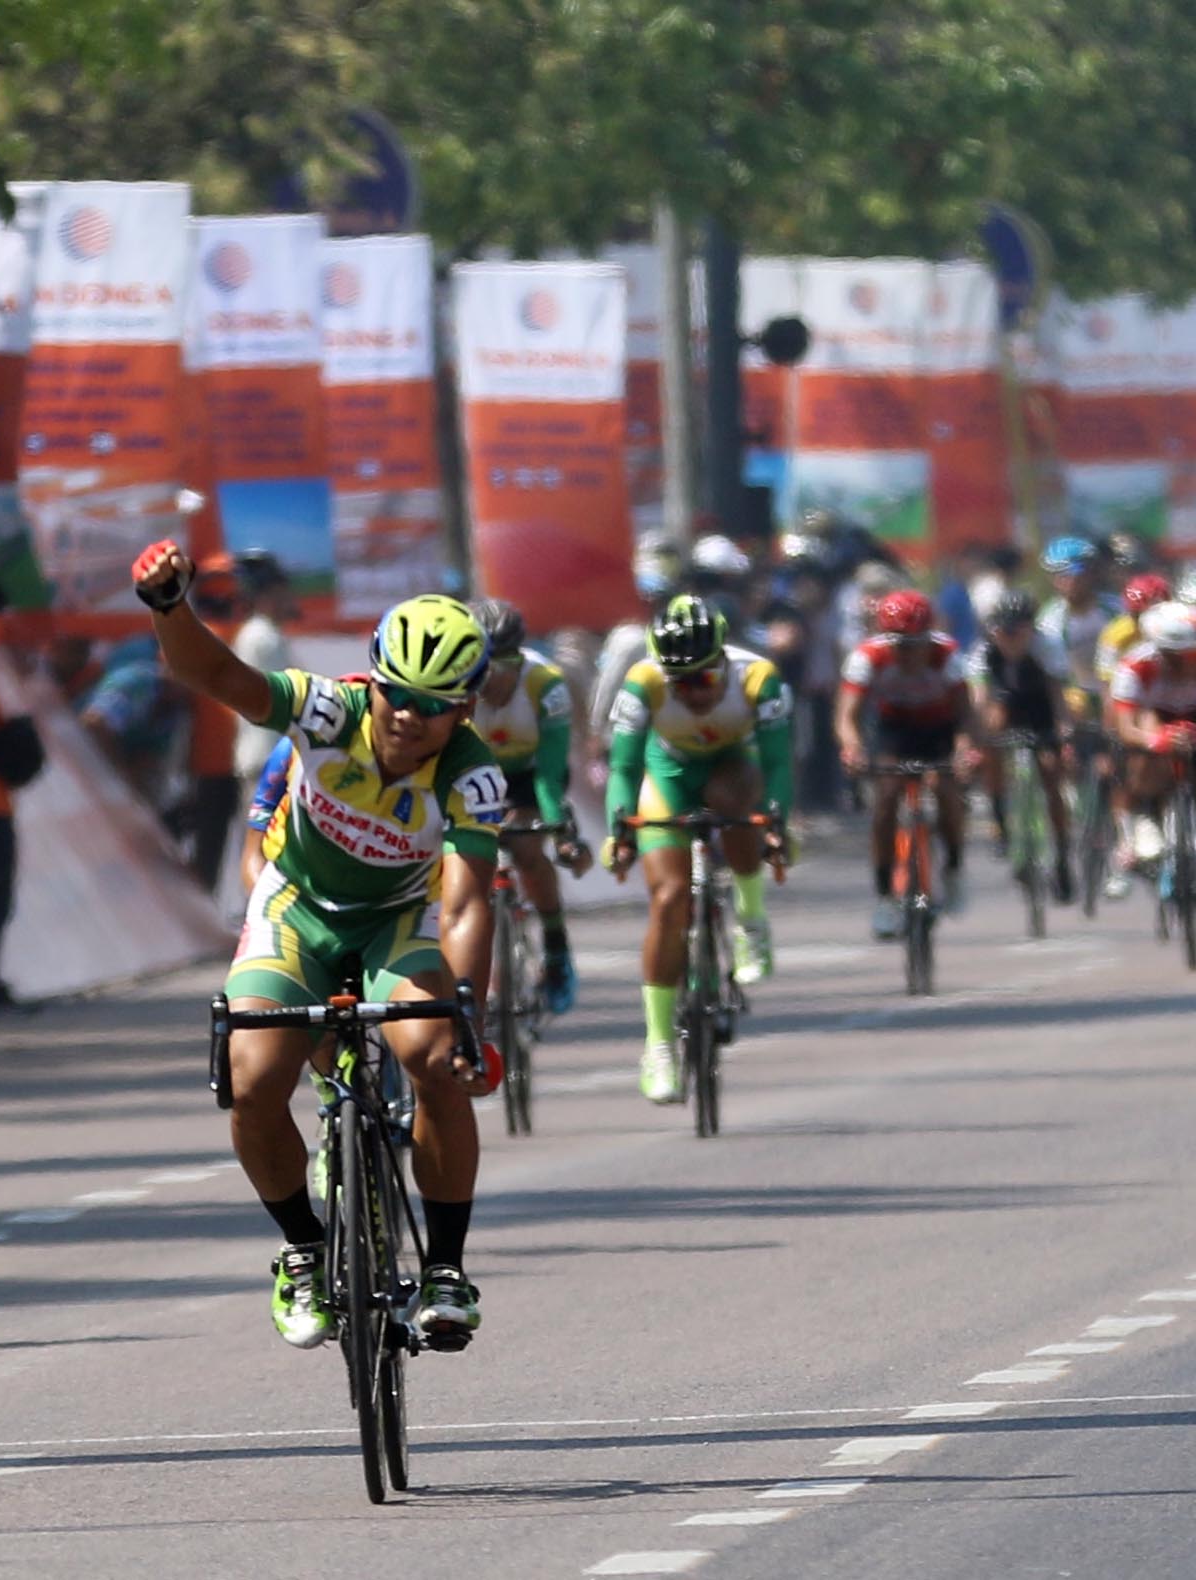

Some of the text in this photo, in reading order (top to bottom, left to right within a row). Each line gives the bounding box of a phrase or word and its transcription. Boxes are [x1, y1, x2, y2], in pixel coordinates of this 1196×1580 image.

[309, 689, 343, 728] 11
[466, 772, 500, 806] 11
[311, 791, 412, 851] THÀNH PHỐ
[318, 819, 363, 852] CHÍ
